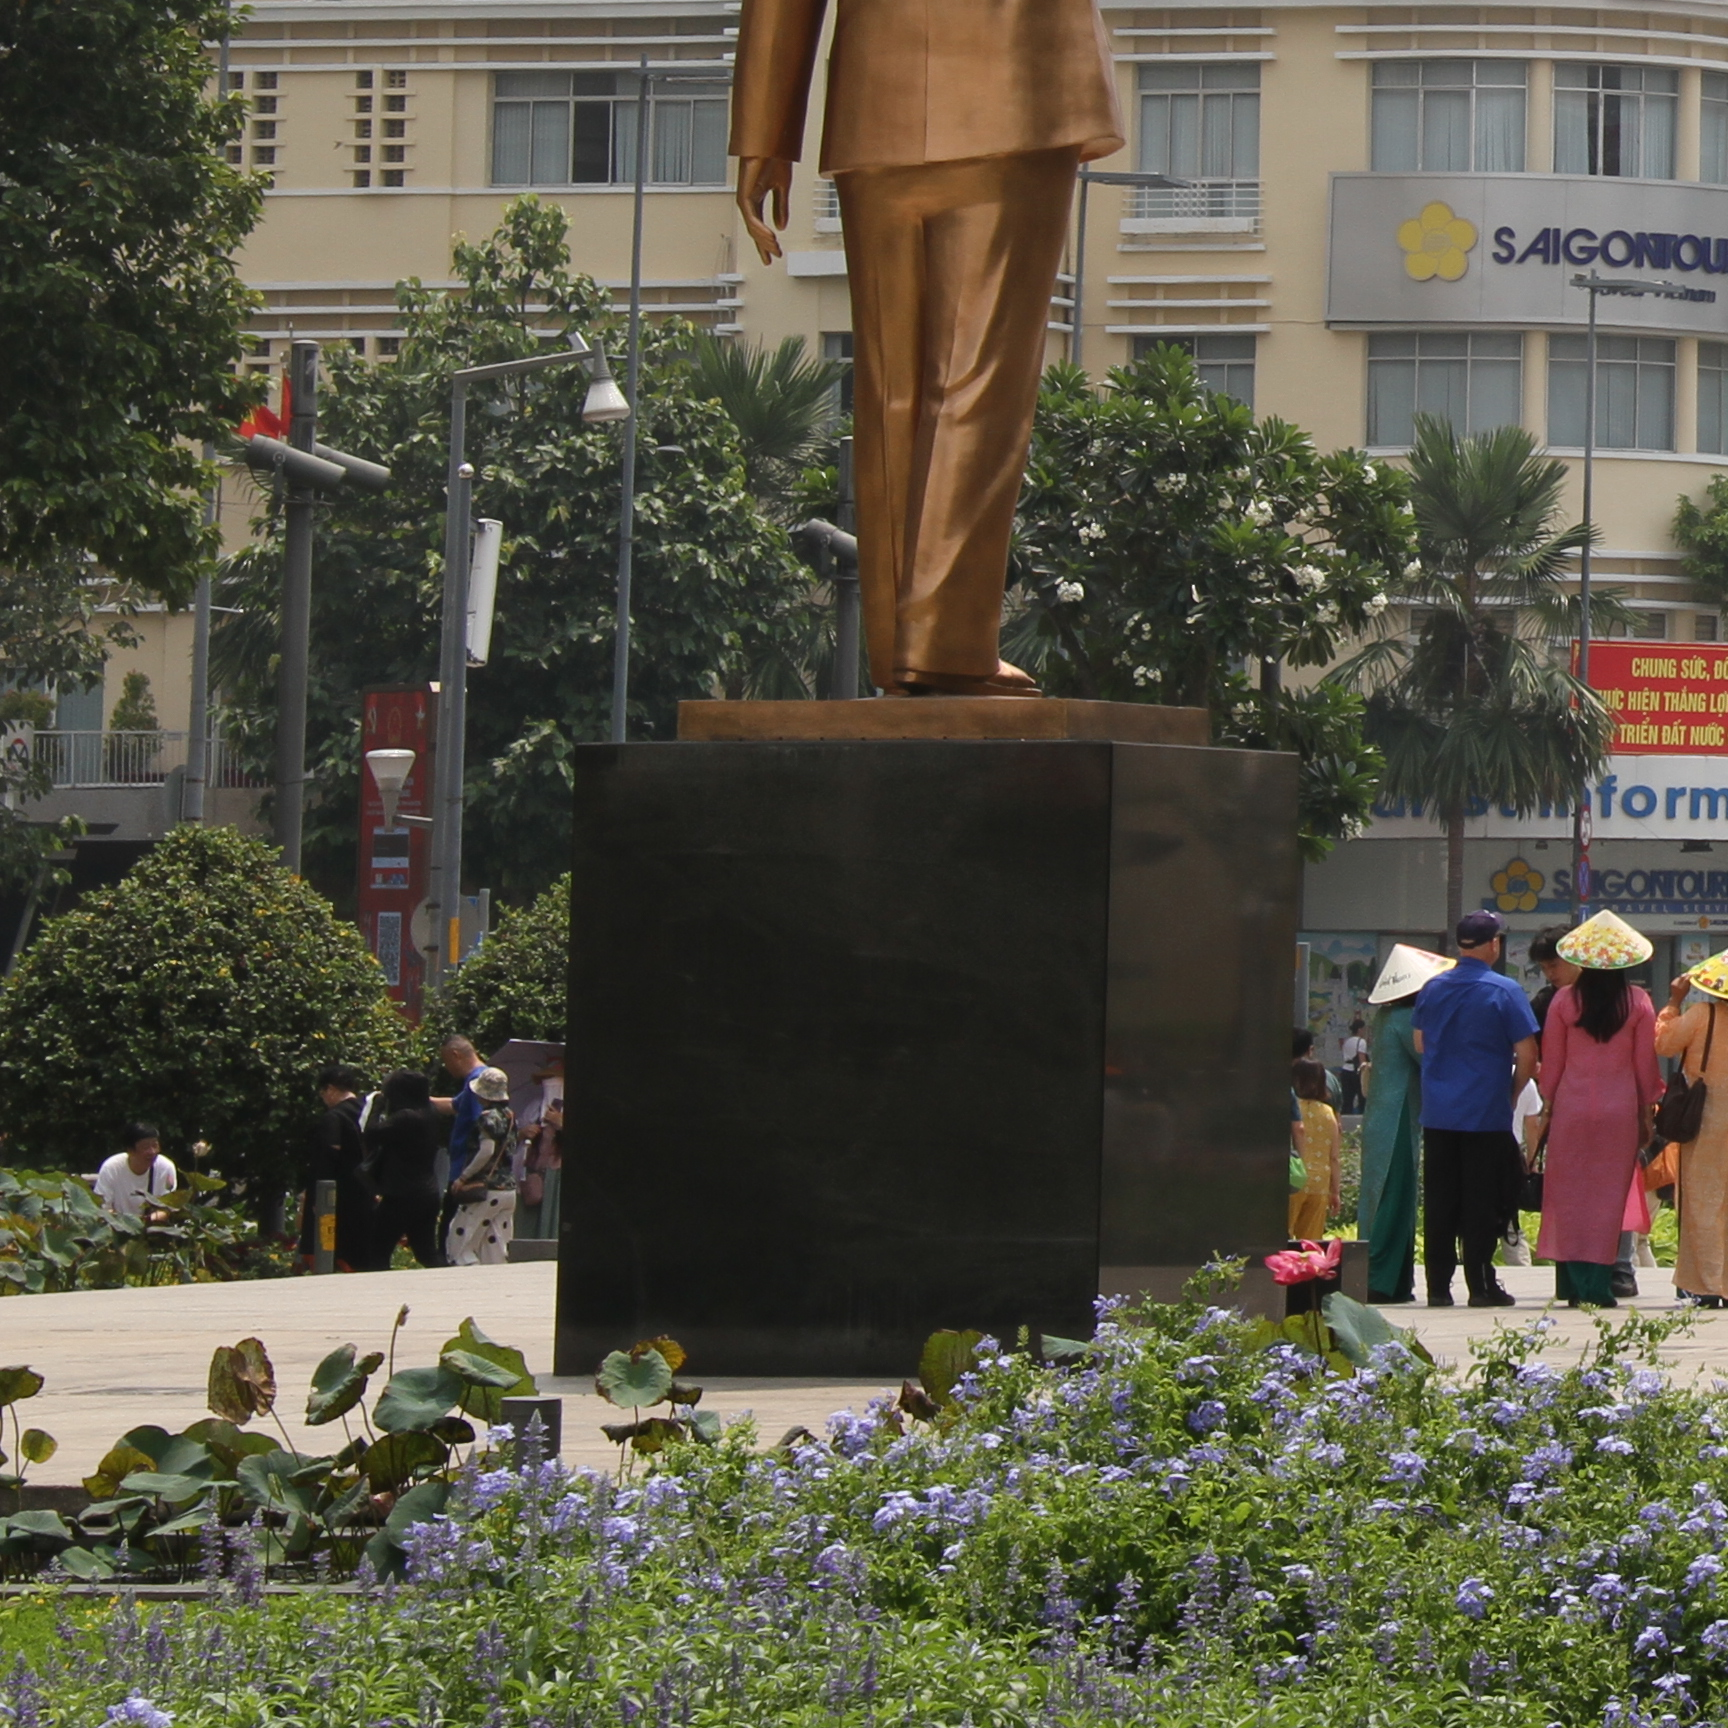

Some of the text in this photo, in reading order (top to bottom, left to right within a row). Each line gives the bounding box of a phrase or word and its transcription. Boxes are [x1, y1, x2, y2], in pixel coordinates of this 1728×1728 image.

[1631, 657, 1677, 678] CHUNG
[1680, 654, 1710, 681] SỨC,
[1628, 688, 1660, 715] HIỆN
[1664, 686, 1706, 713] THẮNG
[1620, 716, 1658, 745] TRIỂN
[1662, 720, 1687, 746] ĐẤT
[1689, 722, 1725, 747] NƯỚC
